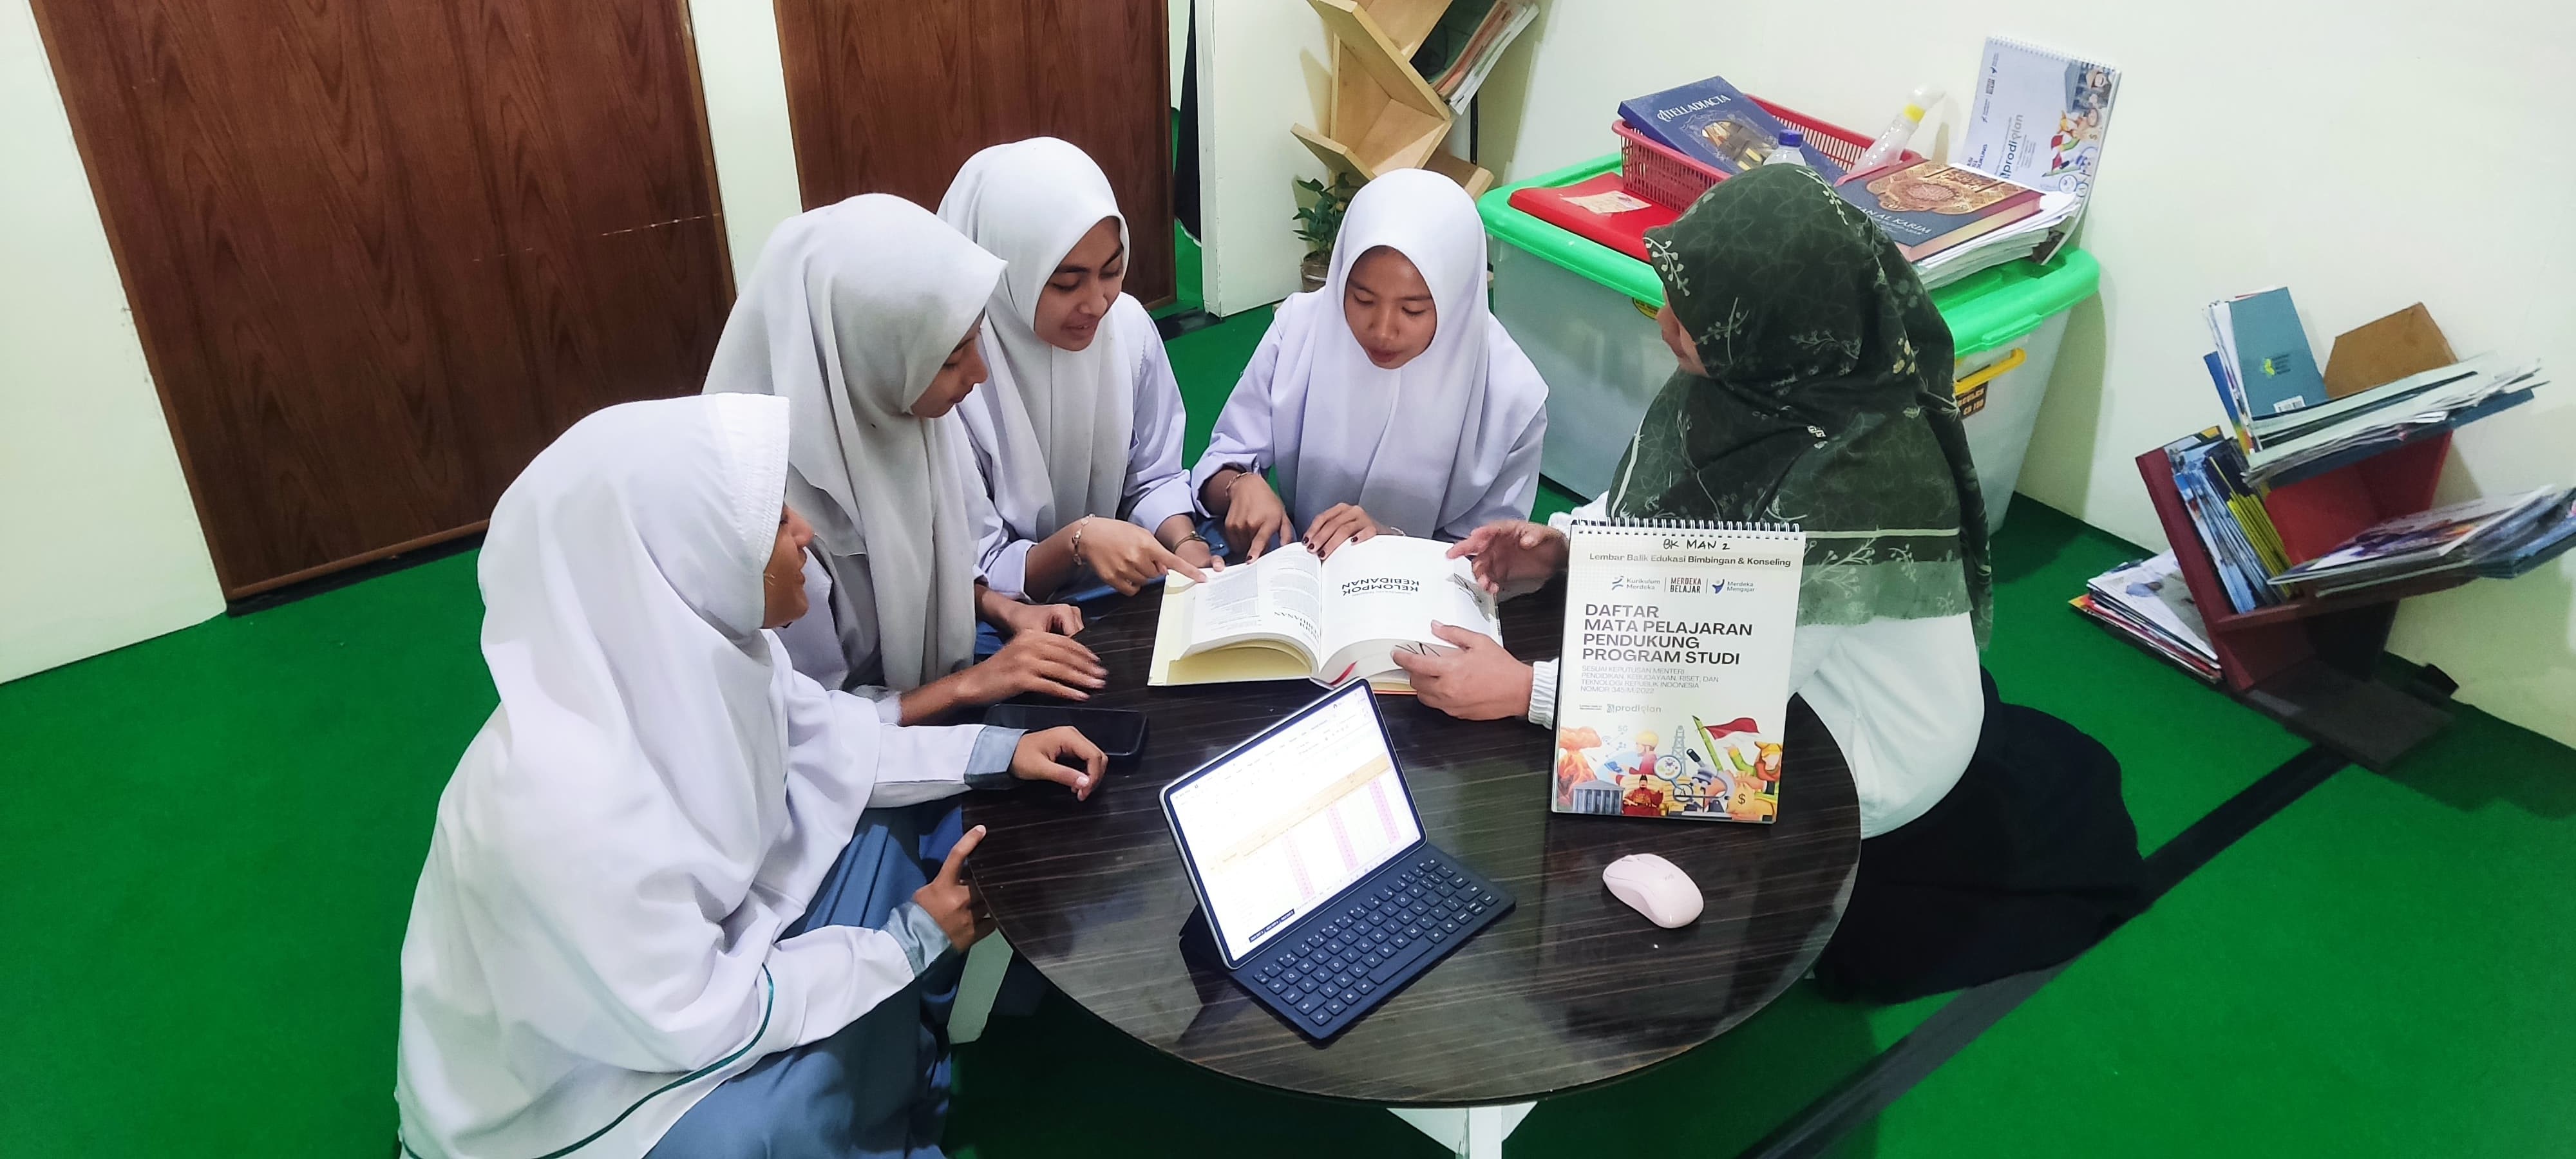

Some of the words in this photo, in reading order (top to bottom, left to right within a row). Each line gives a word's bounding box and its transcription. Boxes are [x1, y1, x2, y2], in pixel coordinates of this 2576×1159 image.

[1892, 218, 1931, 234] KARIM
[1687, 539, 1716, 549] MAN
[1688, 556, 1736, 565] Bimbingan
[1747, 558, 1791, 567] Konseling
[1341, 578, 1419, 590] KEBIDANAN
[1671, 577, 1701, 585] MERDEKA
[1343, 584, 1418, 596] KELOMPOK
[1670, 585, 1701, 593] BELAJAR
[1586, 604, 1659, 618] DAFTAR
[1584, 619, 1638, 632] MATA
[1643, 621, 1752, 636] PELAJARAN
[1584, 634, 1700, 648] PENDUKUNG
[1582, 648, 1680, 663] PROGRAM
[1685, 651, 1739, 664] STUDI
